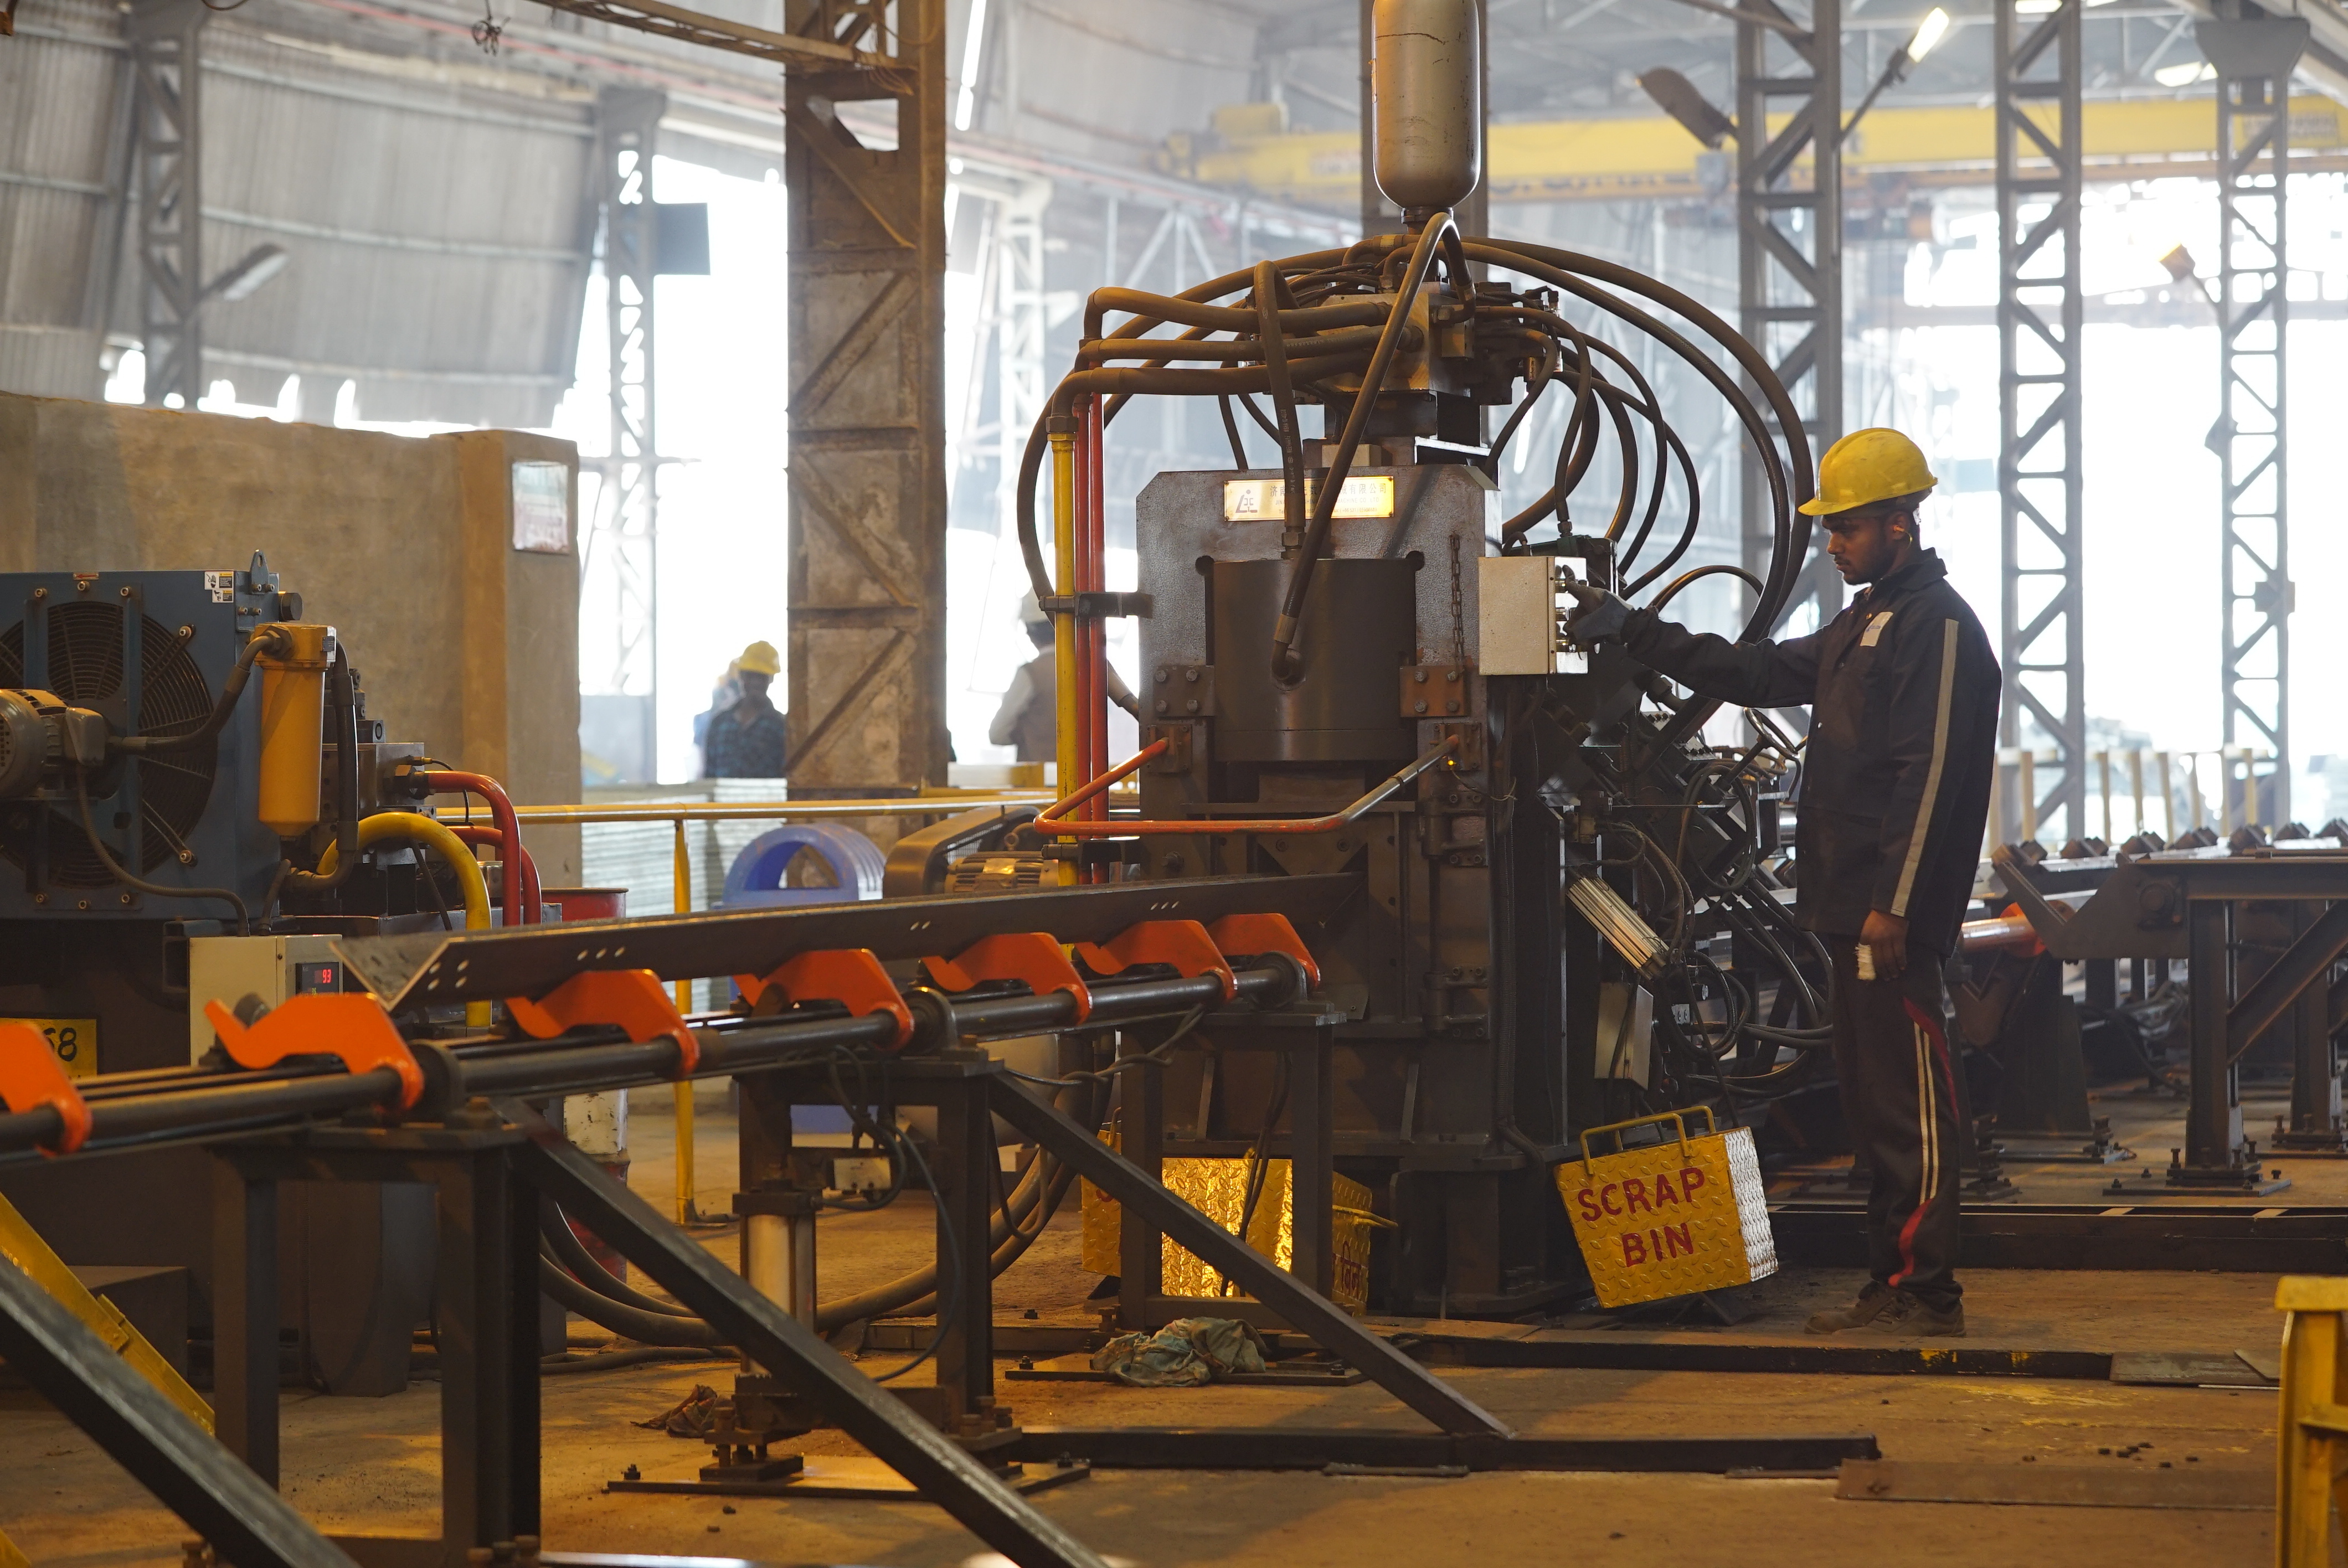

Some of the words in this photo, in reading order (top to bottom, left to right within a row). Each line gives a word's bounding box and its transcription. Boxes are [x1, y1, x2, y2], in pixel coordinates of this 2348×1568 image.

[322, 969, 331, 983] 93
[1578, 1167, 1705, 1222] SCRAP
[1621, 1223, 1695, 1267] BIN
